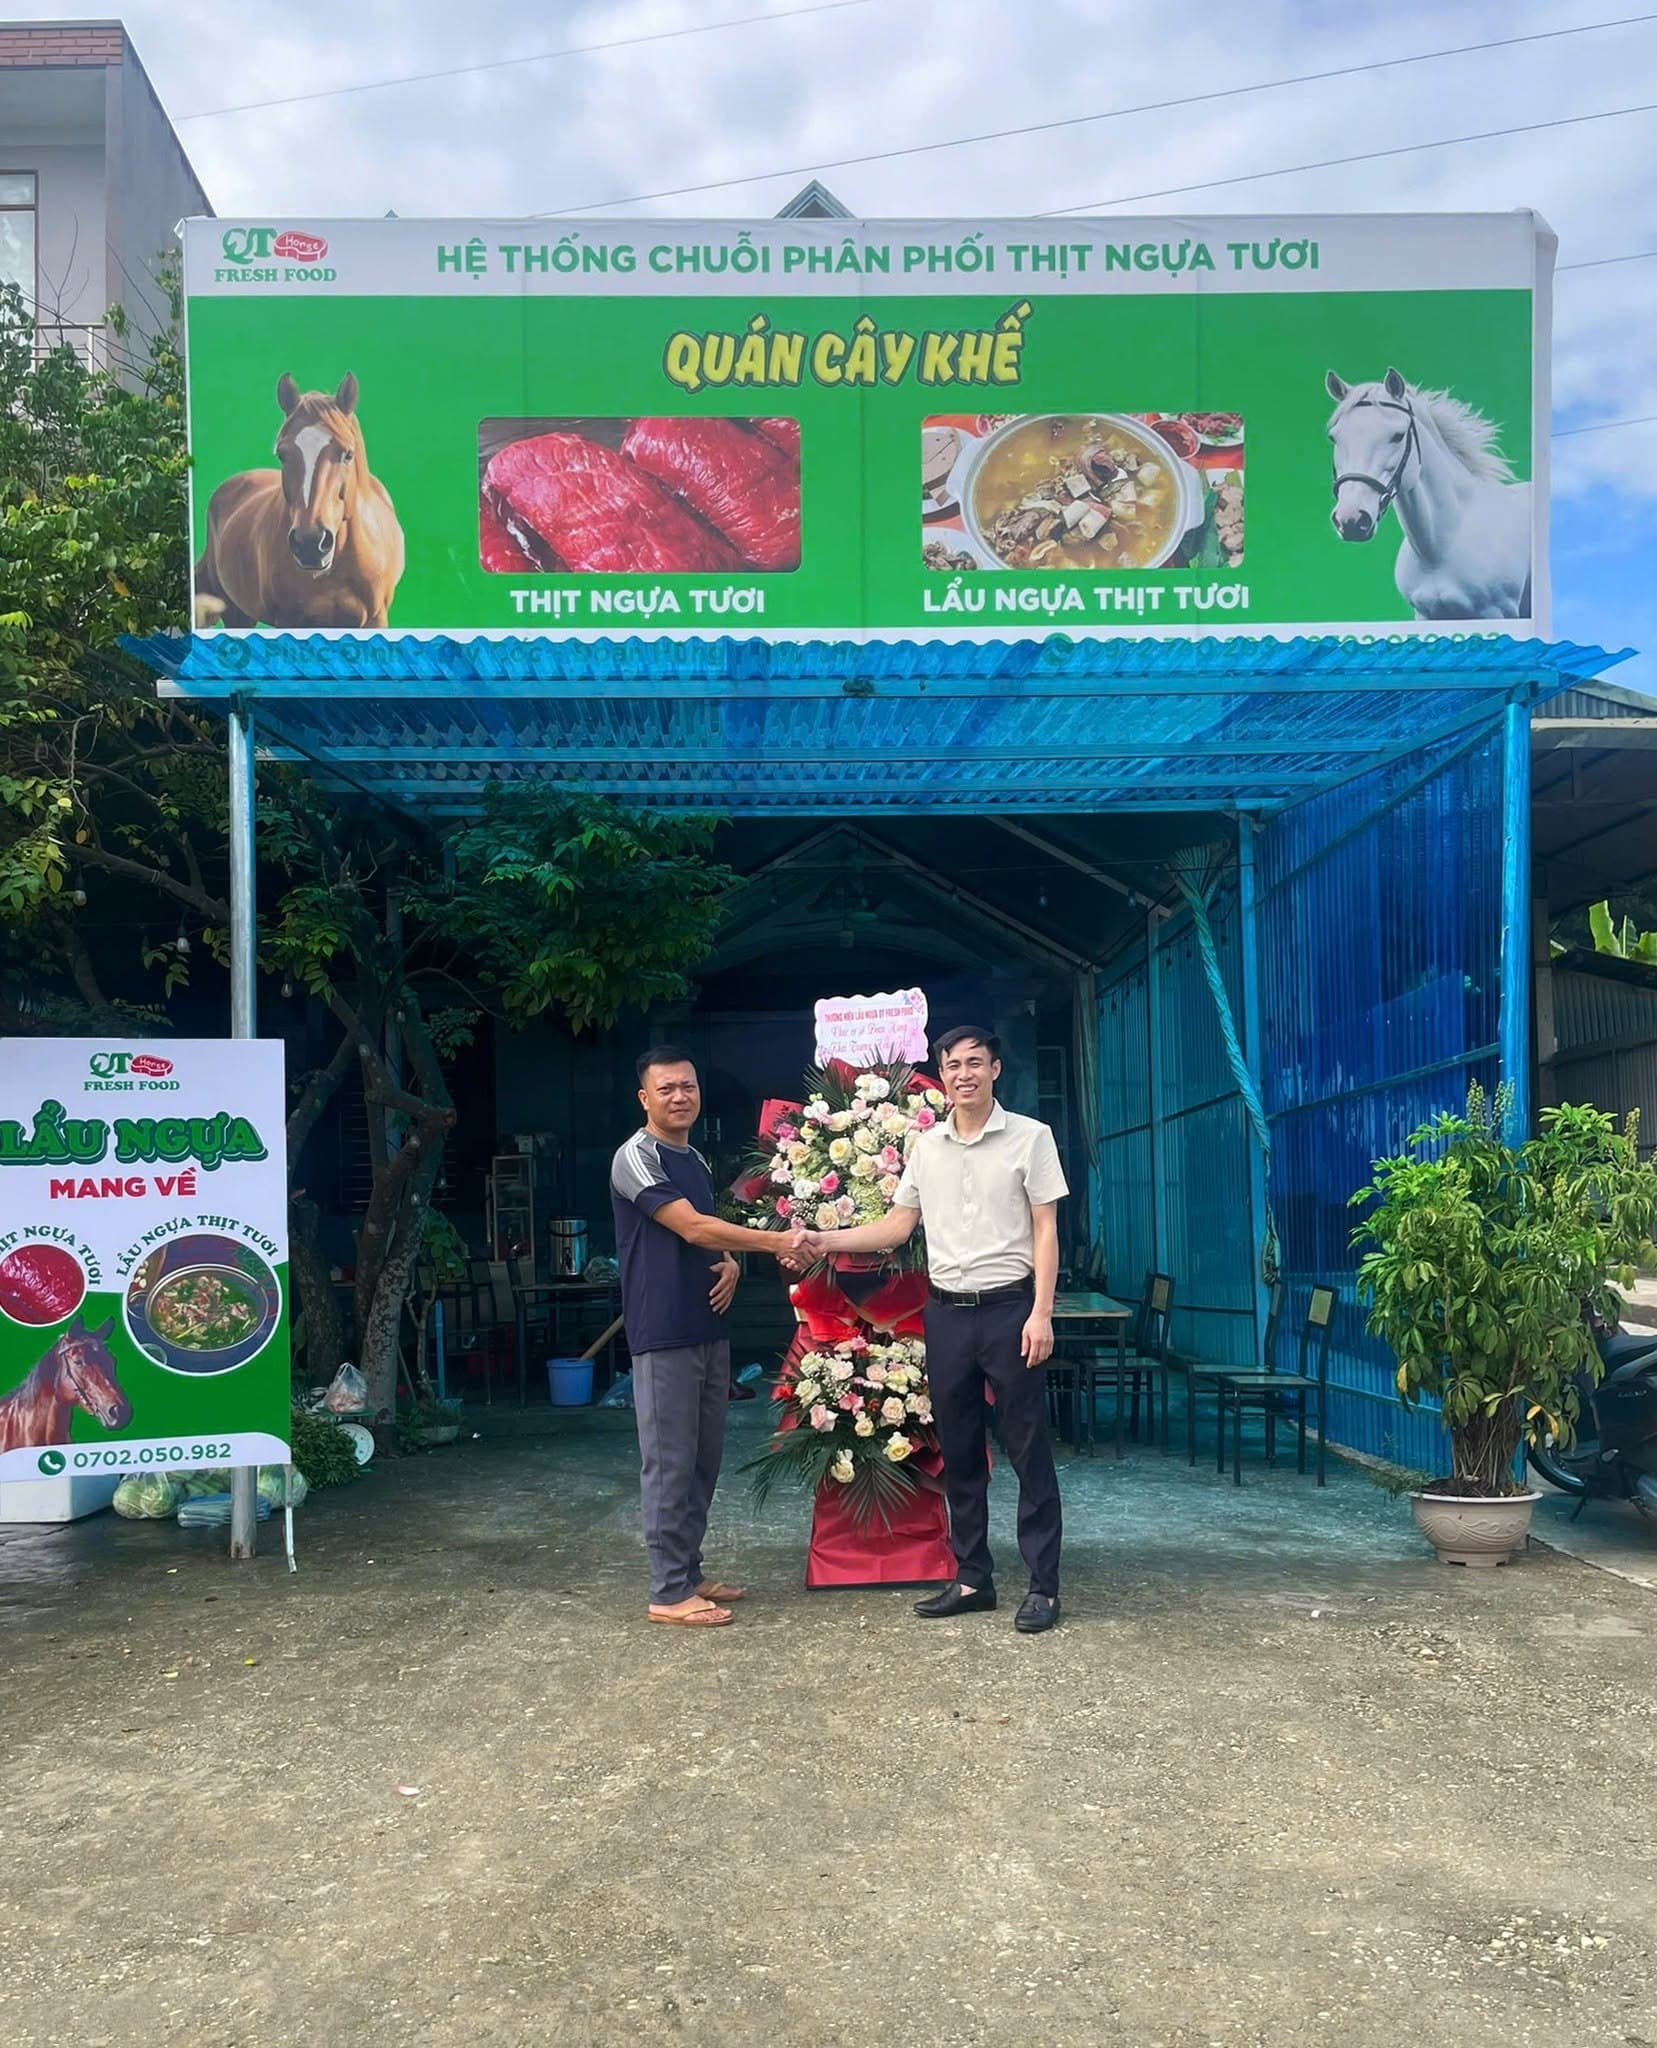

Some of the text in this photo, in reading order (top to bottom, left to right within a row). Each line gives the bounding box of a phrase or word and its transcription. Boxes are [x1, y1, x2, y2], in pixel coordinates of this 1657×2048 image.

[222, 227, 278, 265] QT
[285, 235, 320, 252] Horse
[437, 231, 1320, 280] HỆ THỐNG CHUỖI PHÂN PHỐI THỊT NGỰA TƯƠI
[214, 267, 338, 282] FRESH FOOD
[664, 300, 1032, 392] QUÁN CÂY KHẾ
[509, 586, 765, 620] THỊT NGỰA TƯƠI
[923, 577, 1250, 617] LẨU NGỰA THỊT TƯƠI
[90, 1052, 133, 1078] QT
[139, 1058, 166, 1069] Horse
[84, 1080, 180, 1091] FRESH FOOD
[0, 1099, 268, 1172] LẨU NGỰA
[50, 1167, 197, 1199] MANG VỀ
[141, 1217, 193, 1247] NGỰA
[197, 1215, 240, 1231] THỊT
[243, 1225, 280, 1258] TƯƠI
[0, 1225, 104, 1286] ỊT NGỰA TƯƠI
[73, 1443, 232, 1468] 0702.050.982
